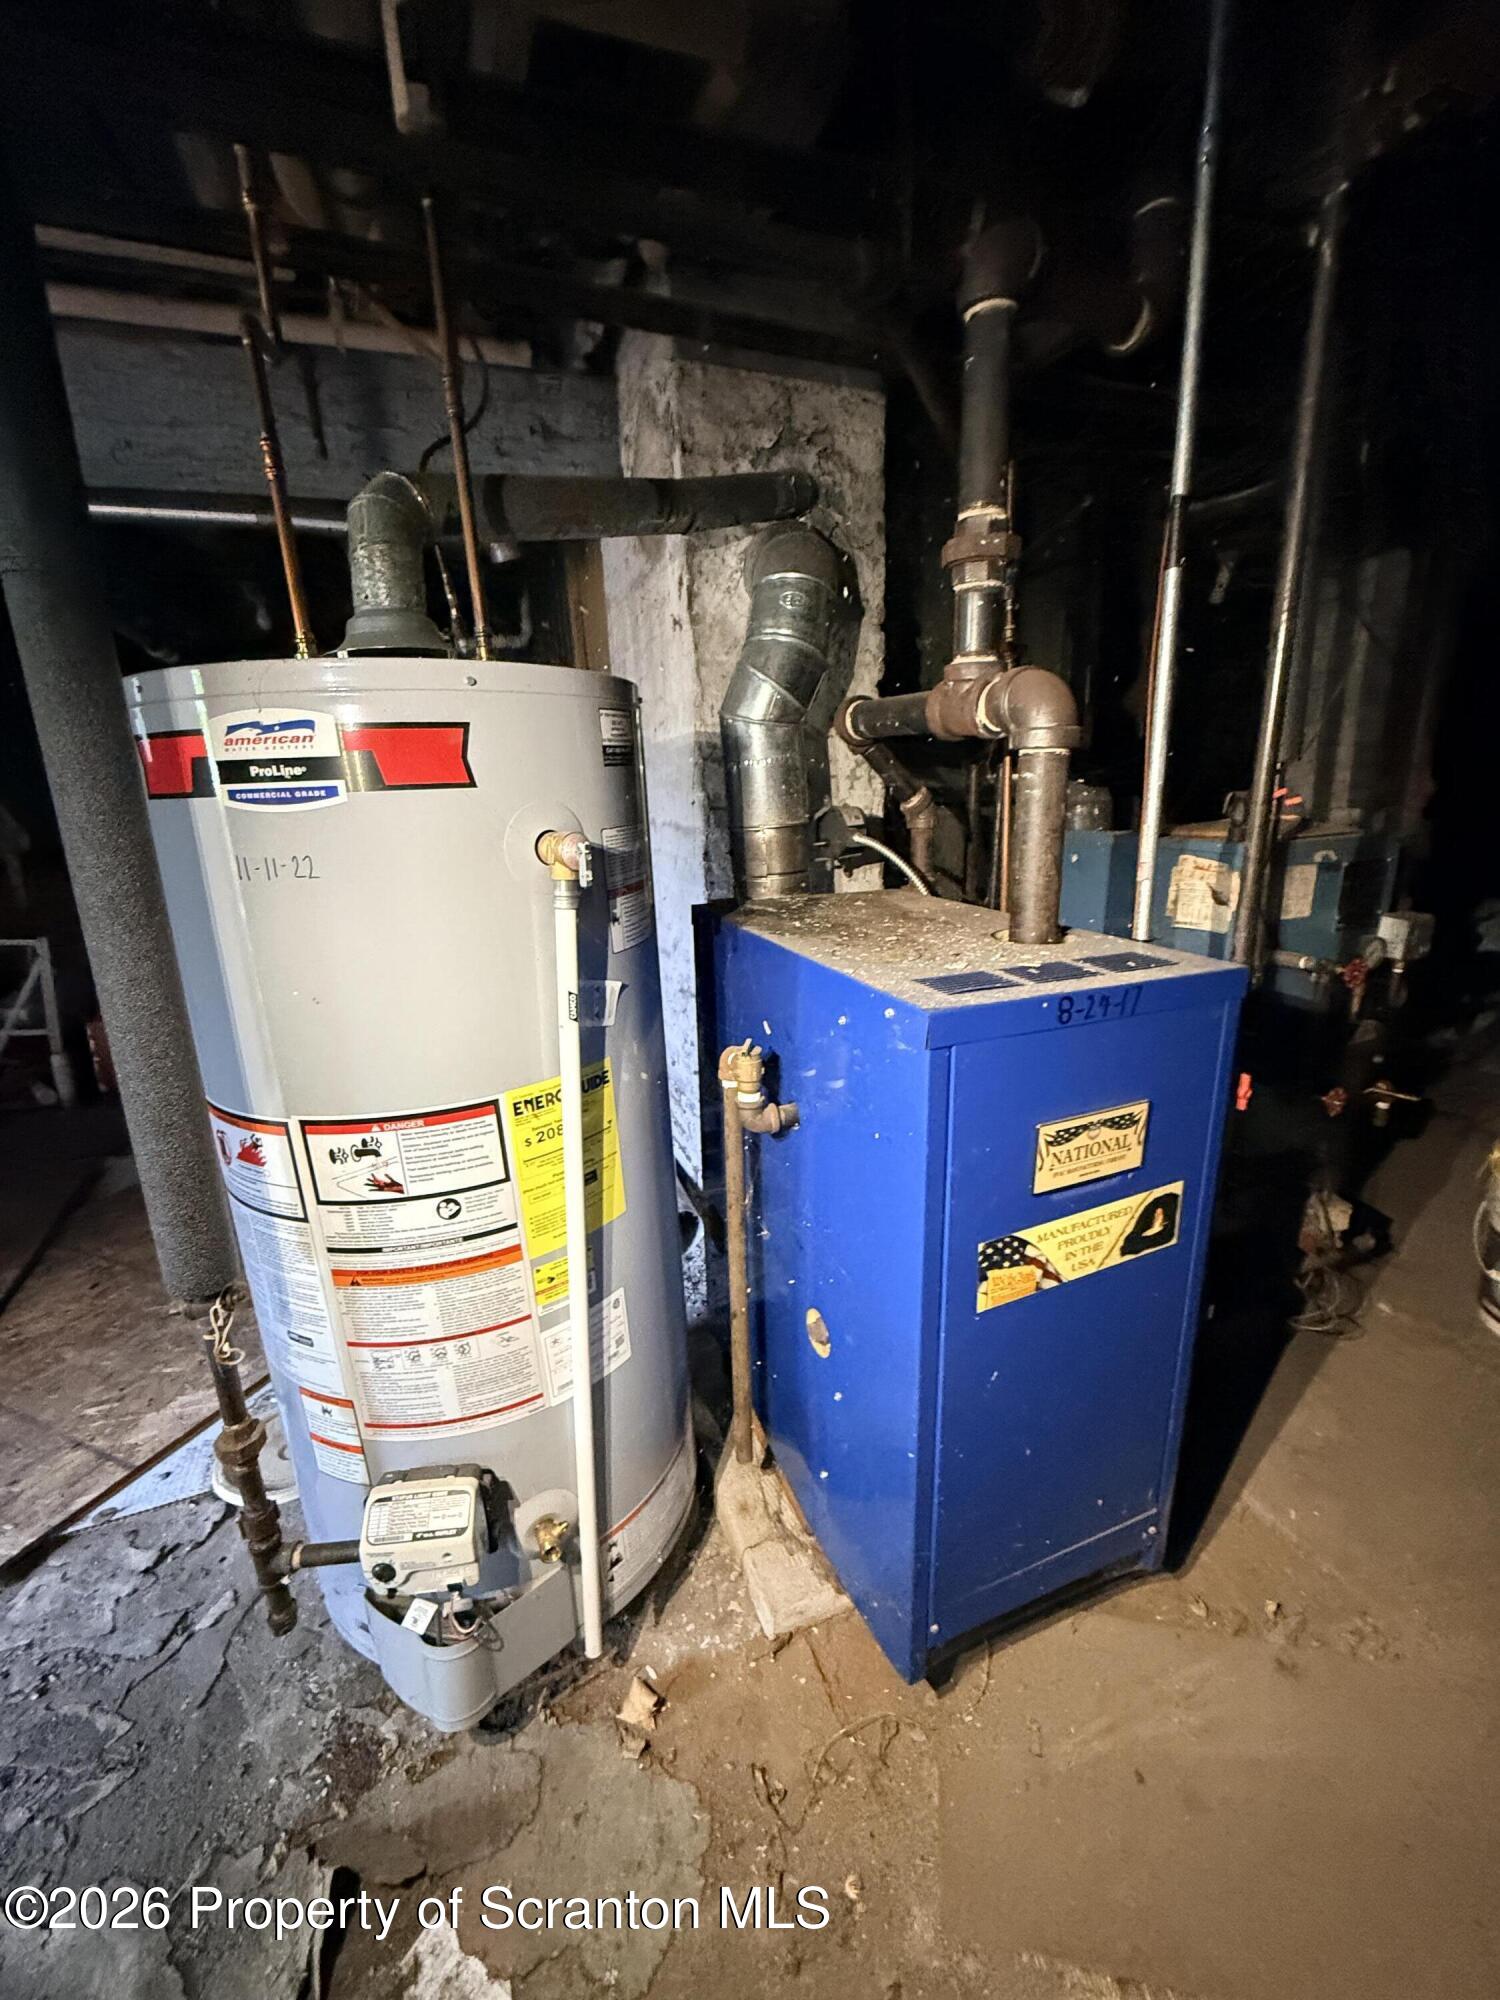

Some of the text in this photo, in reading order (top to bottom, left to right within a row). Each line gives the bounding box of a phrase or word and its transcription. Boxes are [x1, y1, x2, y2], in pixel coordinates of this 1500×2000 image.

[223, 734, 315, 747] american
[235, 789, 327, 800] COMMERCIAL GRADE
[235, 855, 321, 881] 11-11-22
[383, 1119, 425, 1131] DANGER
[1051, 1134, 1132, 1167] NATIONAL
[1036, 1206, 1133, 1243] MANUFACTURED
[1057, 1226, 1113, 1250] PROUDLY
[1071, 1258, 1096, 1272] USA
